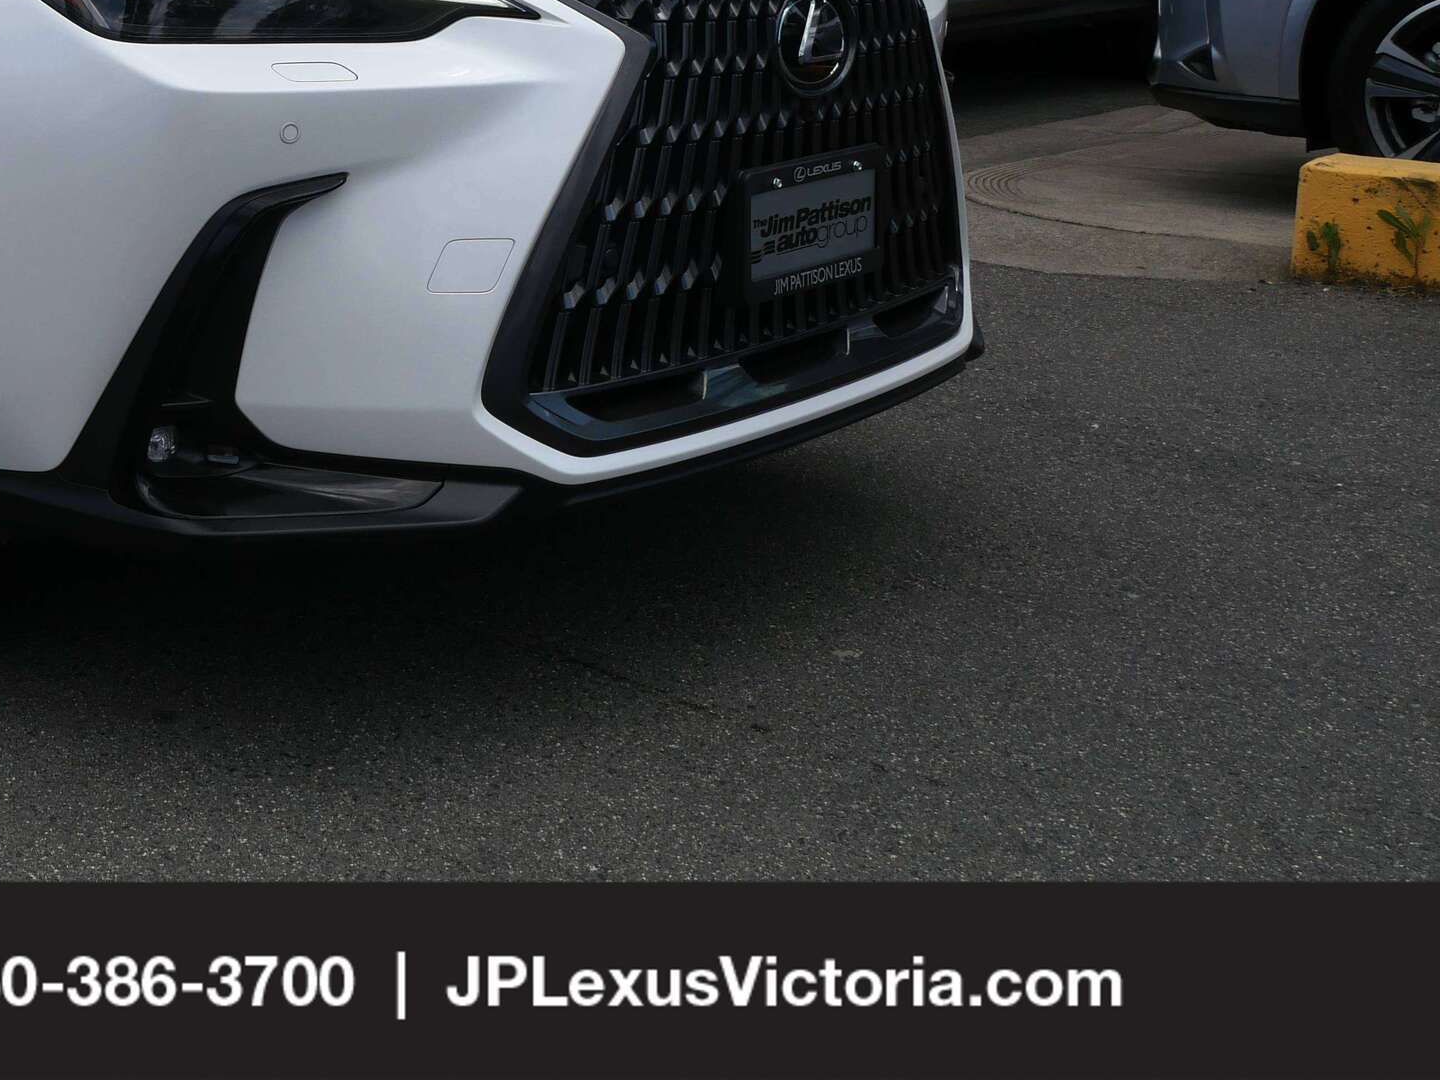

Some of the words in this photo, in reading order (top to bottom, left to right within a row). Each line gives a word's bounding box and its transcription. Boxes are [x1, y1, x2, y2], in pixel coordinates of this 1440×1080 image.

[806, 160, 842, 177] LEXUS
[773, 277, 789, 296] JIM
[790, 265, 833, 291] PATTISON
[834, 257, 862, 279] LEXUS
